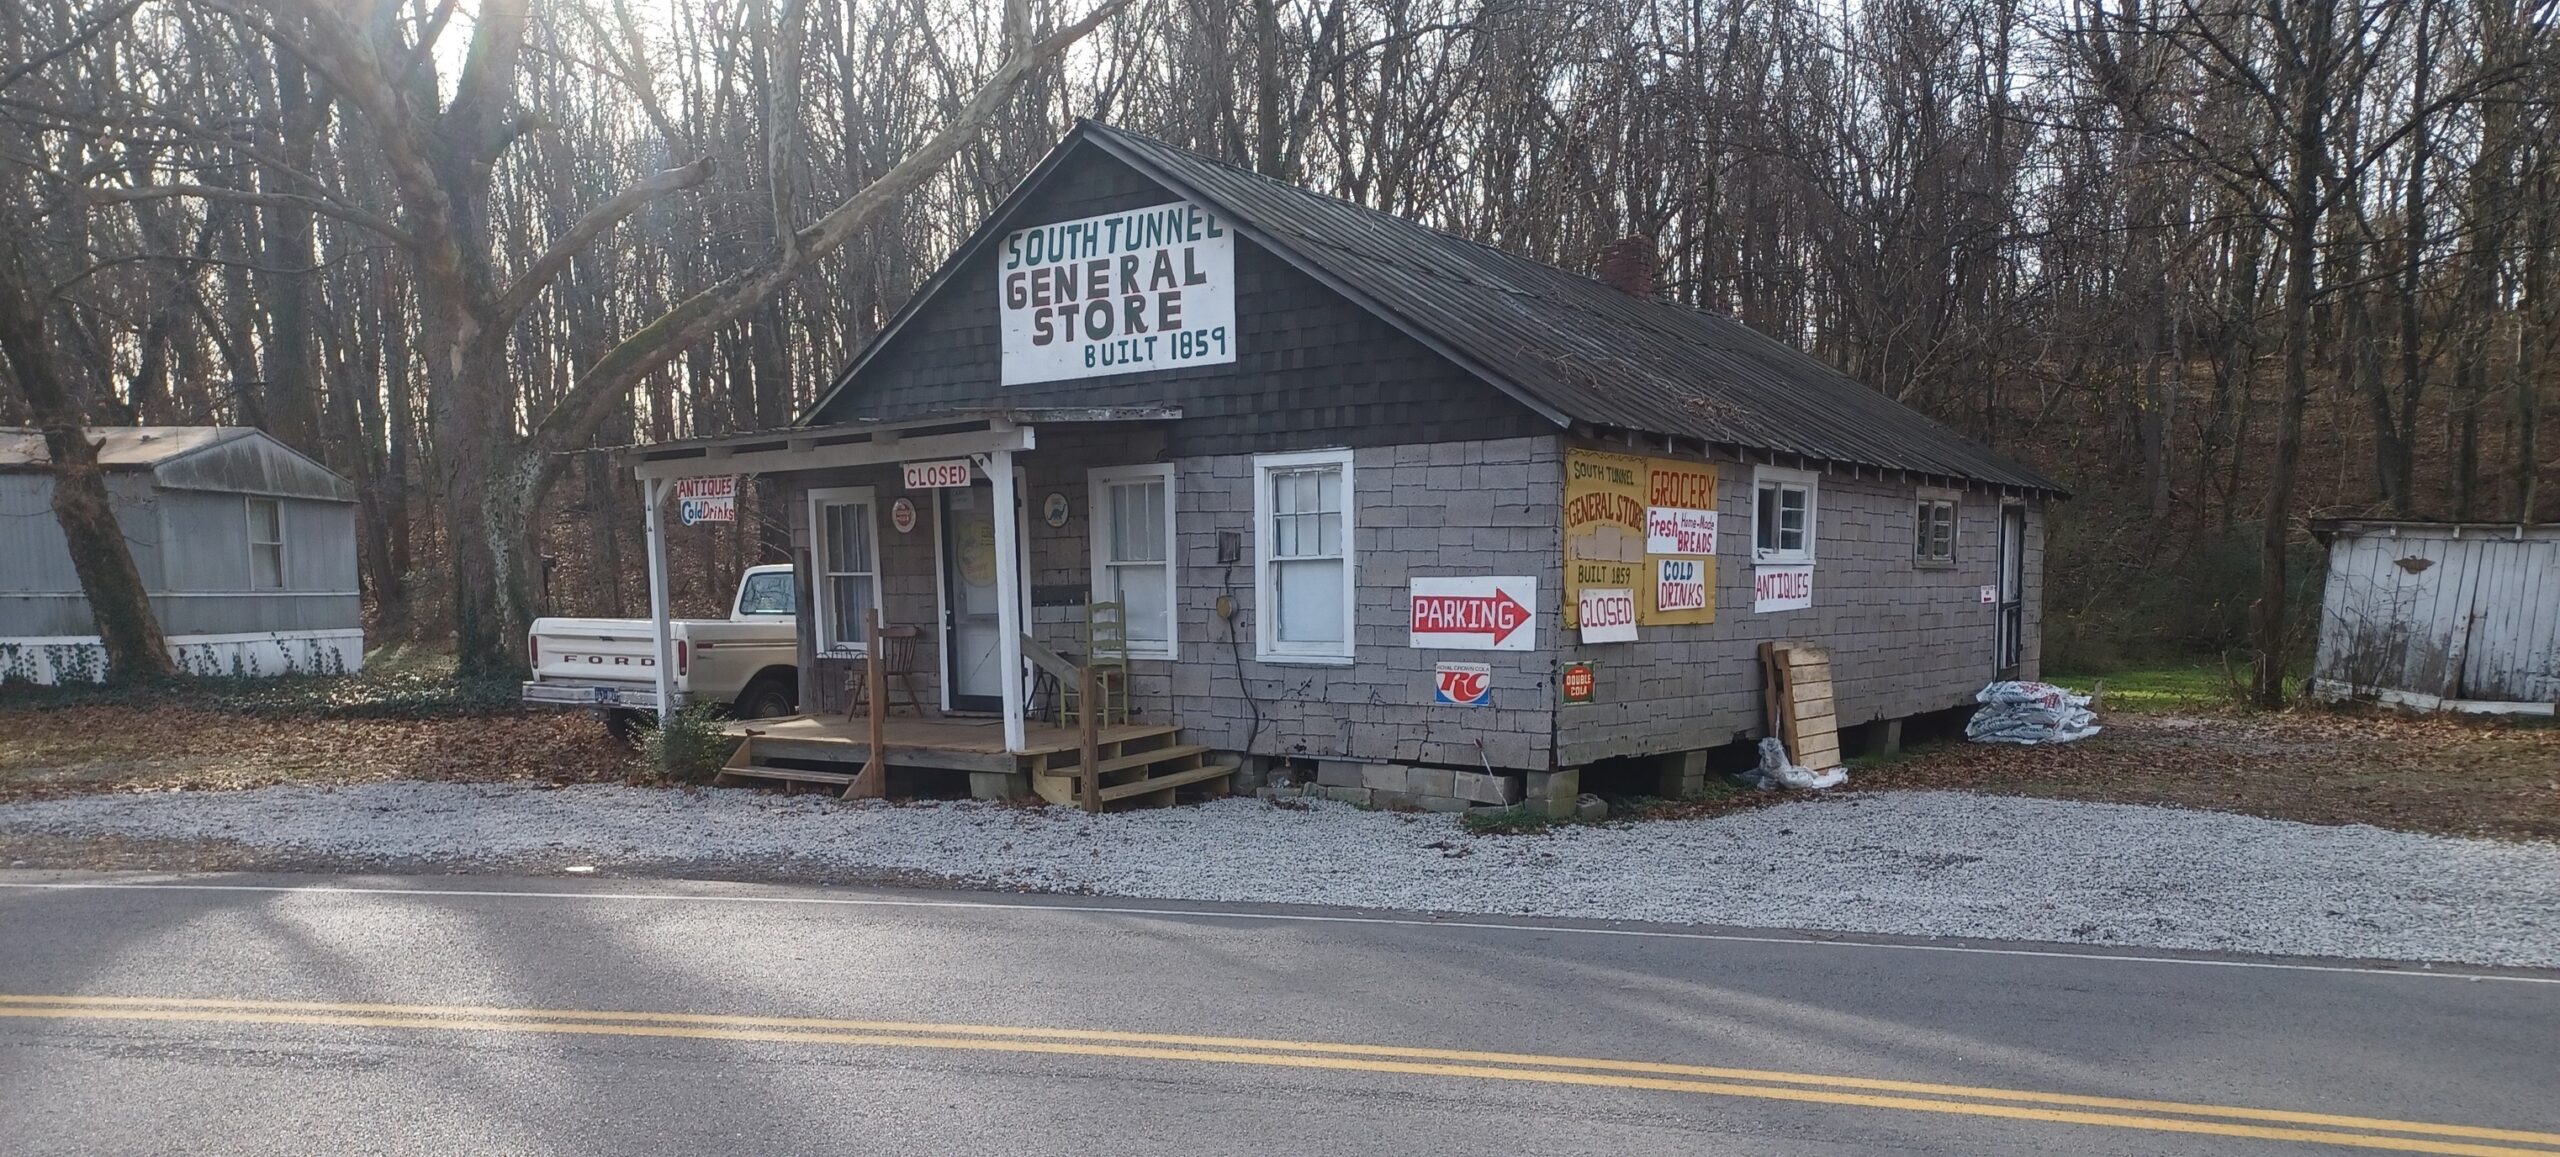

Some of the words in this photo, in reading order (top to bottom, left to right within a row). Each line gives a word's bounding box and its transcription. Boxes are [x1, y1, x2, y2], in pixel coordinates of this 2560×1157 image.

[1007, 221, 1098, 269] SOUTH
[1105, 204, 1223, 254] TUNNEL
[1006, 247, 1207, 310] GENERAL
[1033, 291, 1182, 346] STORE
[1084, 336, 1157, 368] BUILT
[1171, 326, 1225, 360] 1859
[907, 465, 966, 487] CLOSED
[1574, 461, 1604, 480] SOUTH
[1606, 466, 1634, 486] TUNNEL
[678, 478, 732, 498] ANTIQUES
[1650, 470, 1716, 510] GROCERY
[682, 501, 703, 524] Cold
[702, 501, 734, 520] Drinks
[1568, 492, 1614, 528] GENERAL
[1616, 493, 1644, 532] STORE
[1648, 510, 1678, 539] Fresh
[1680, 513, 1715, 531] Home-Made
[1677, 530, 1713, 553] BREADS
[1578, 565, 1607, 583] BUILT
[1611, 567, 1631, 584] 1859
[1663, 560, 1694, 582] COLD
[1660, 582, 1703, 609] DRINKS
[1755, 572, 1809, 601] ANTIQUES
[1415, 599, 1514, 630] PARKING
[1580, 597, 1632, 628] CLOSED
[564, 655, 655, 666] FORD
[1437, 671, 1489, 702] RC
[1566, 673, 1592, 686] DOUBLE
[1570, 686, 1588, 696] COLA
